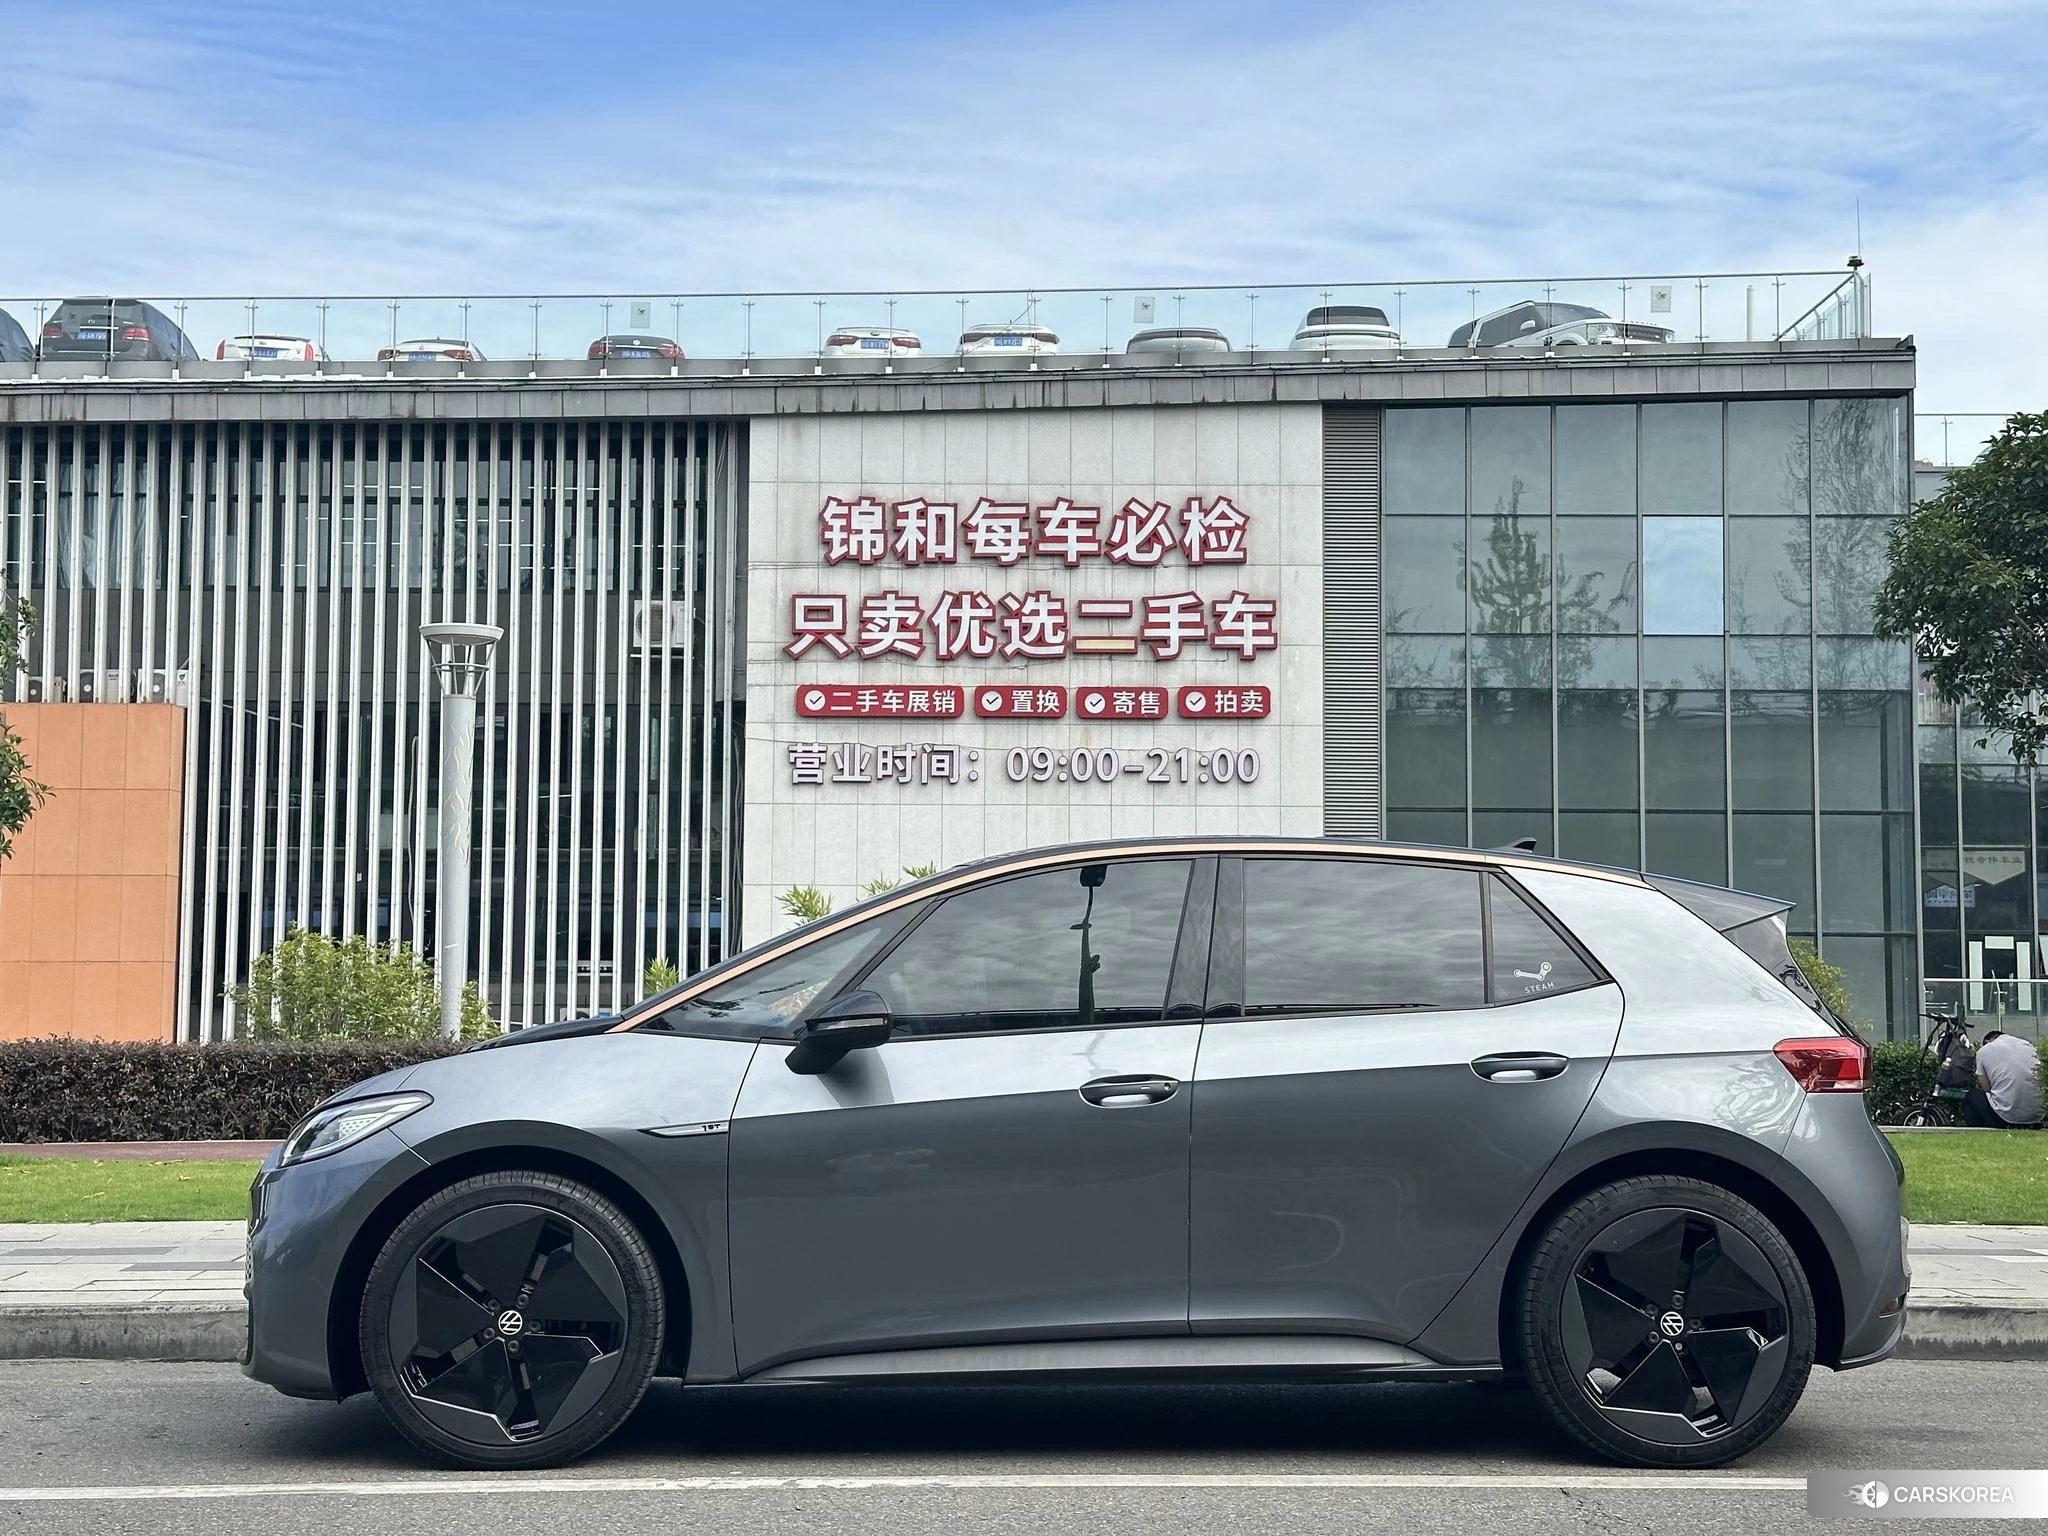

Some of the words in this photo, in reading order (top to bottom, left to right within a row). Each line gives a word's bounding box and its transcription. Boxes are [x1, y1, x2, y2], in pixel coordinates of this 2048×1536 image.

[820, 497, 1250, 567] 锦和每车必检
[785, 591, 1278, 660] 只卖优选二手车
[830, 690, 957, 713] 二手车展销
[1010, 690, 1061, 713] 置换
[1113, 690, 1162, 714] 寄售
[1213, 690, 1264, 714] 拍卖
[1524, 982, 1555, 993] STEAM
